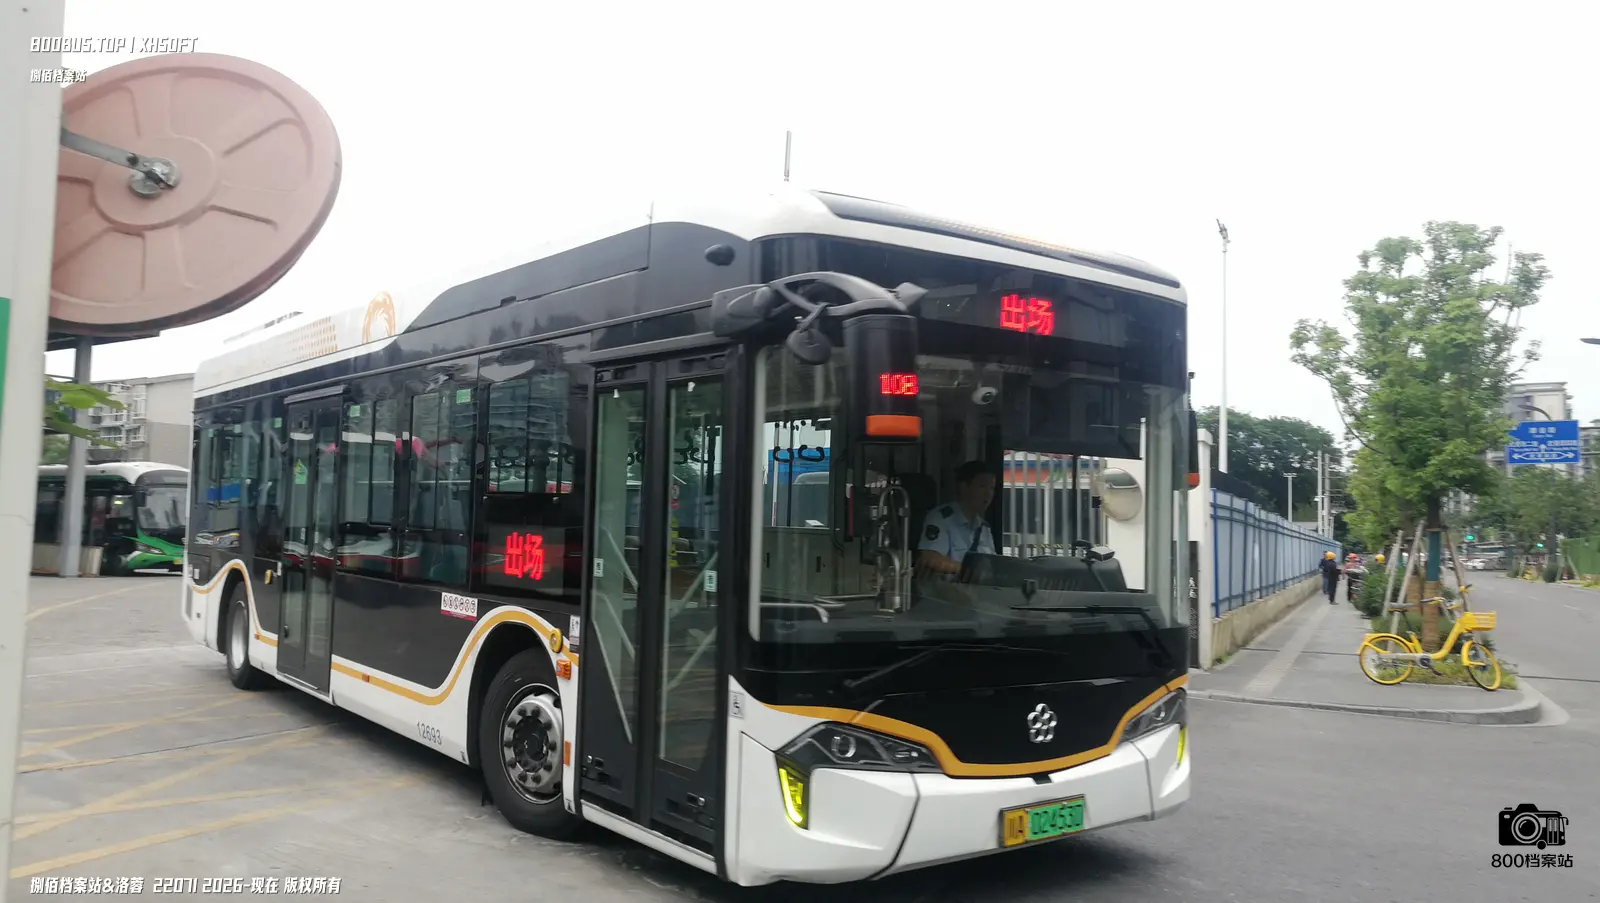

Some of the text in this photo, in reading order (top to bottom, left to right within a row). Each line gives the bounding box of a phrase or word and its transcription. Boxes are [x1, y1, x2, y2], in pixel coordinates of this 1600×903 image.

[999, 294, 1055, 336] 出场
[504, 532, 544, 580] 出场
[416, 721, 443, 746] 12693
